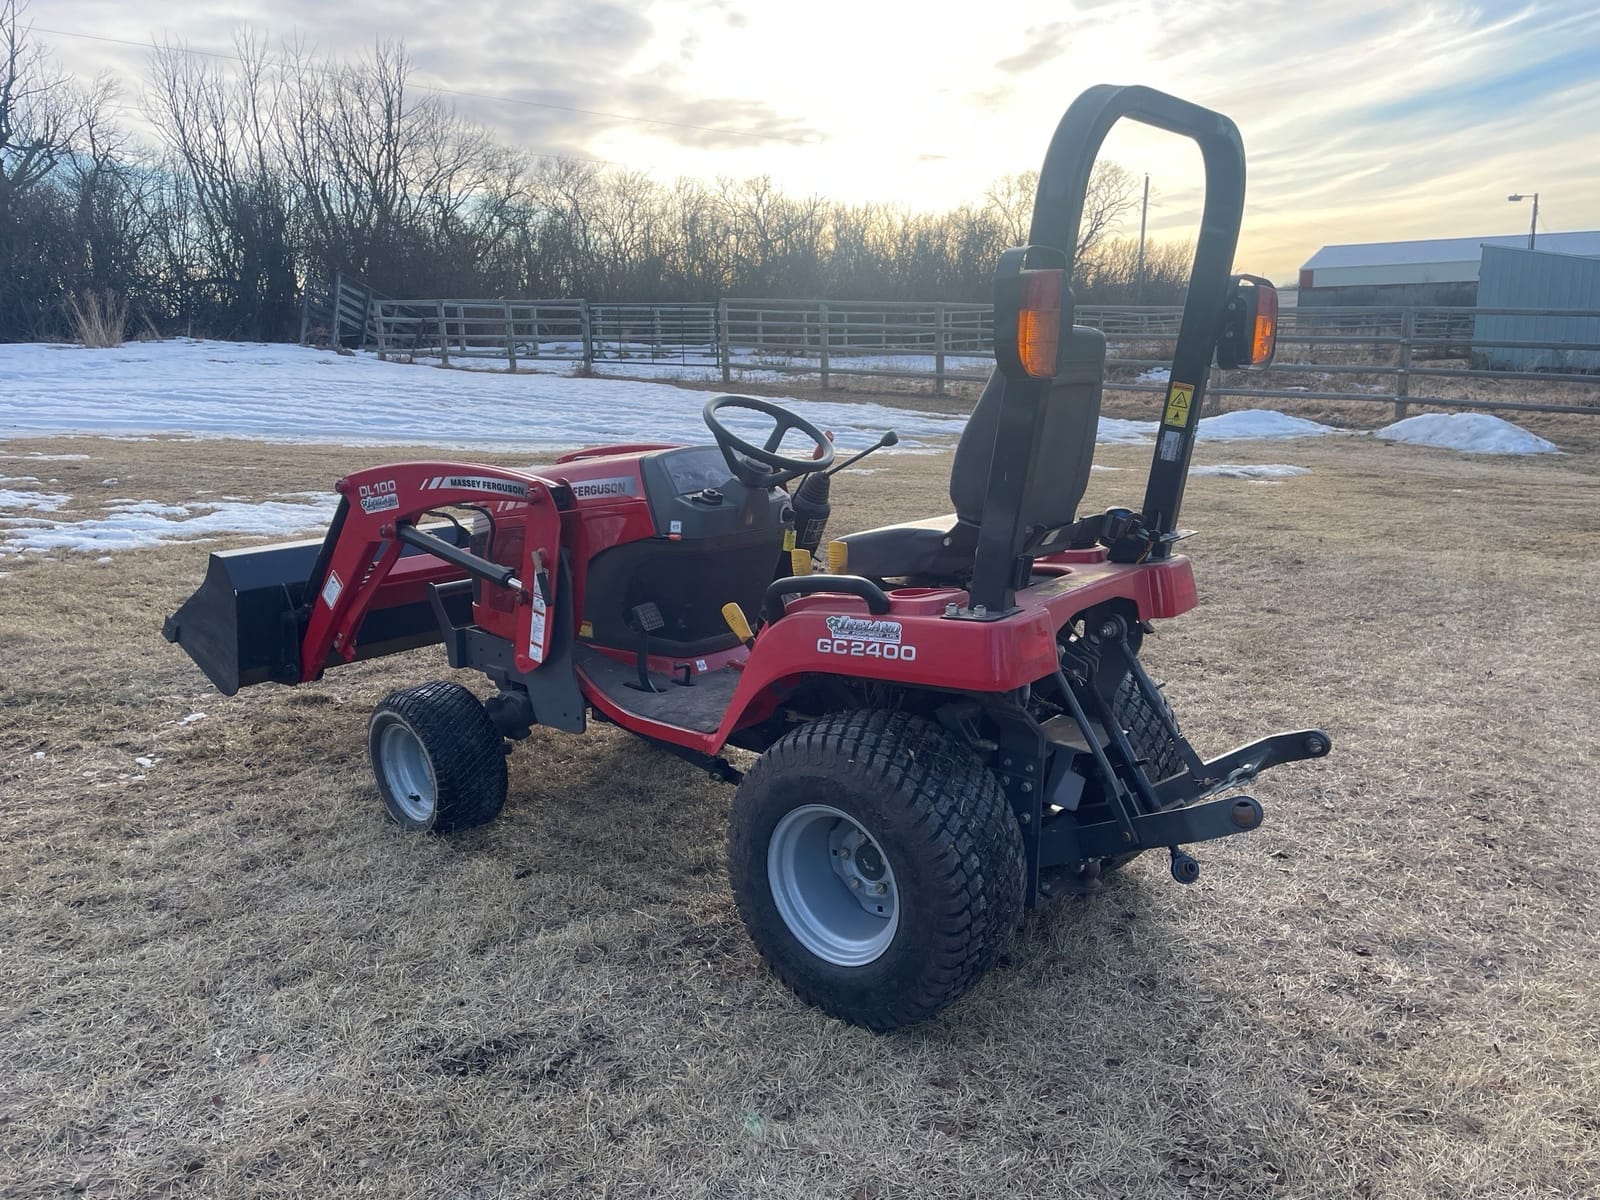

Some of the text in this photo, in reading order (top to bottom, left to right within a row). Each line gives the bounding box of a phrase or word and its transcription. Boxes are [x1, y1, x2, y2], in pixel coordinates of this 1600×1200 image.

[359, 480, 396, 497] DL100
[450, 479, 525, 495] MASSEY FERGUSON
[817, 638, 916, 661] GC2400
